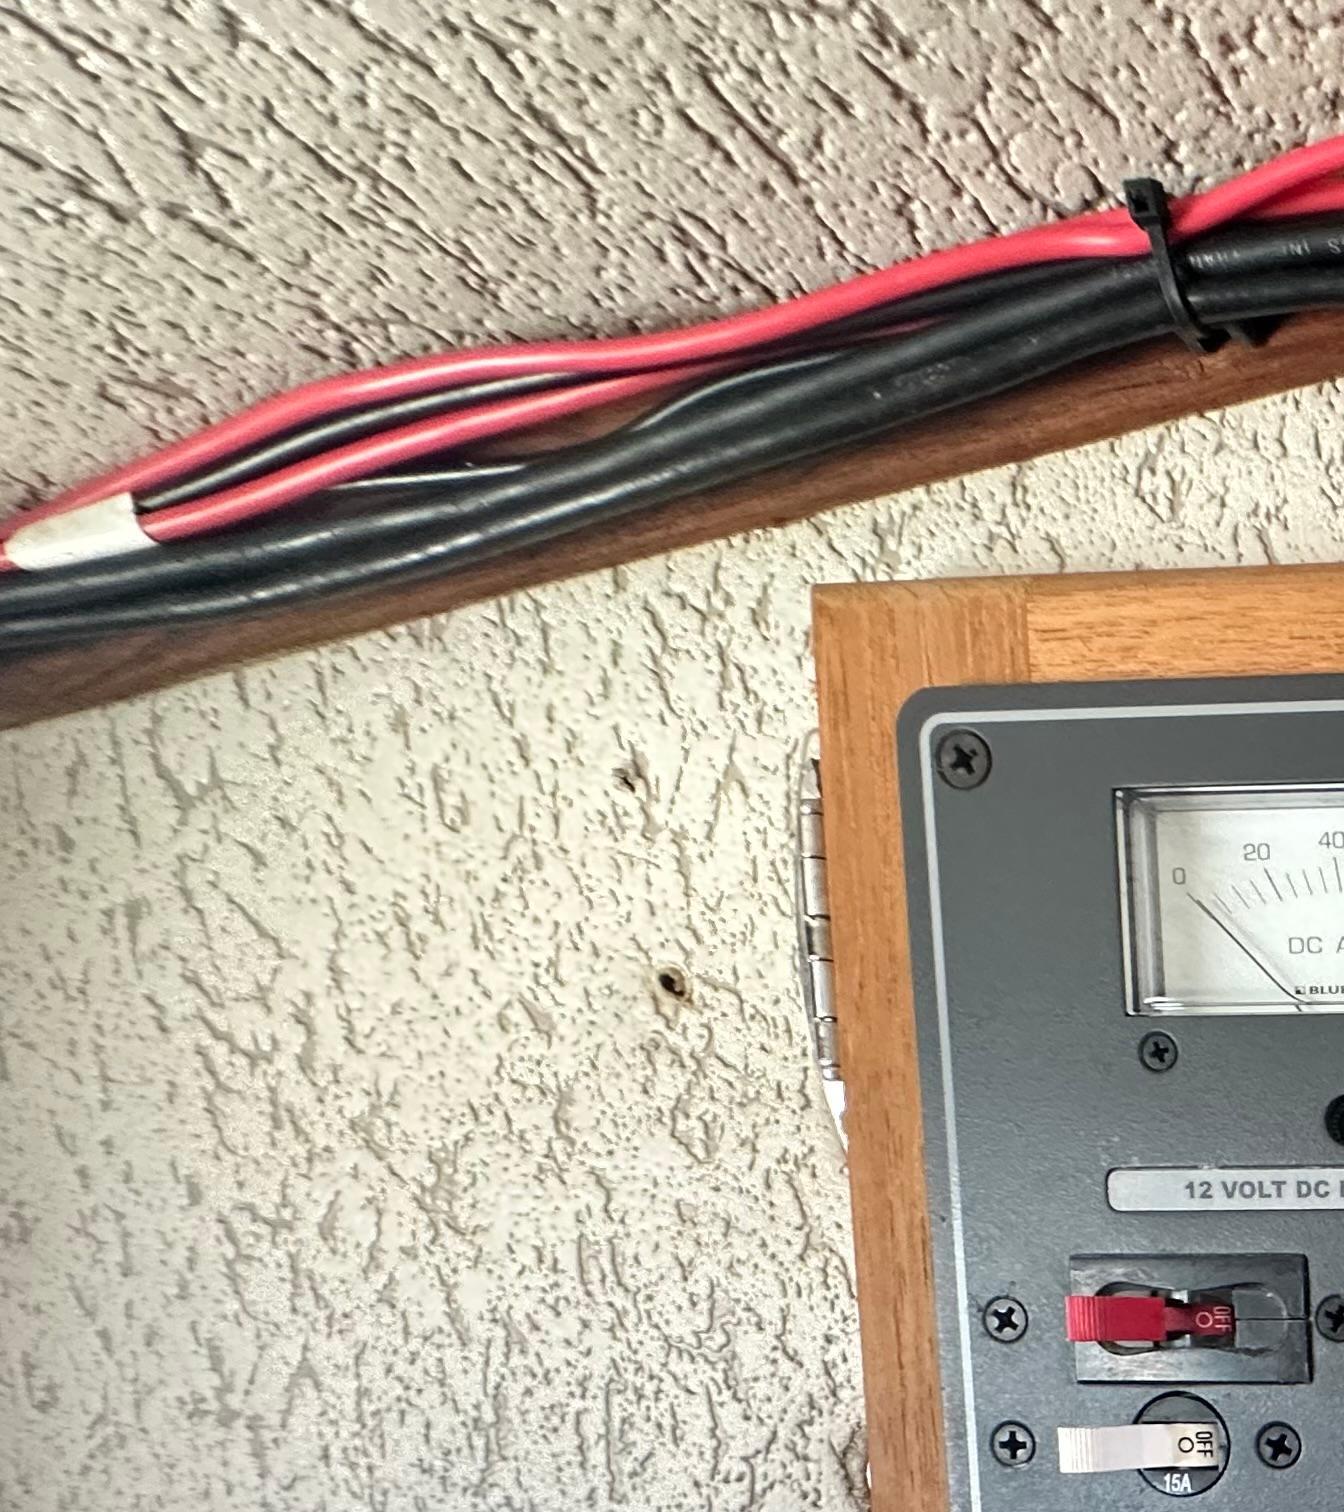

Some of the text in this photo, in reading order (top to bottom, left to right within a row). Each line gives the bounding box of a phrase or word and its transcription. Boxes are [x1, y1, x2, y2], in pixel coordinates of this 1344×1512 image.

[1318, 831, 1344, 849] 40
[1243, 844, 1270, 860] 20
[1173, 868, 1185, 885] 0
[1289, 937, 1323, 954] DC
[1185, 1181, 1212, 1199] 12
[1222, 1180, 1287, 1199] VOLT
[1296, 1180, 1330, 1198] DC
[1213, 1305, 1232, 1332] OFF
[1195, 1431, 1214, 1458] OFF
[1163, 1474, 1191, 1492] 15A
